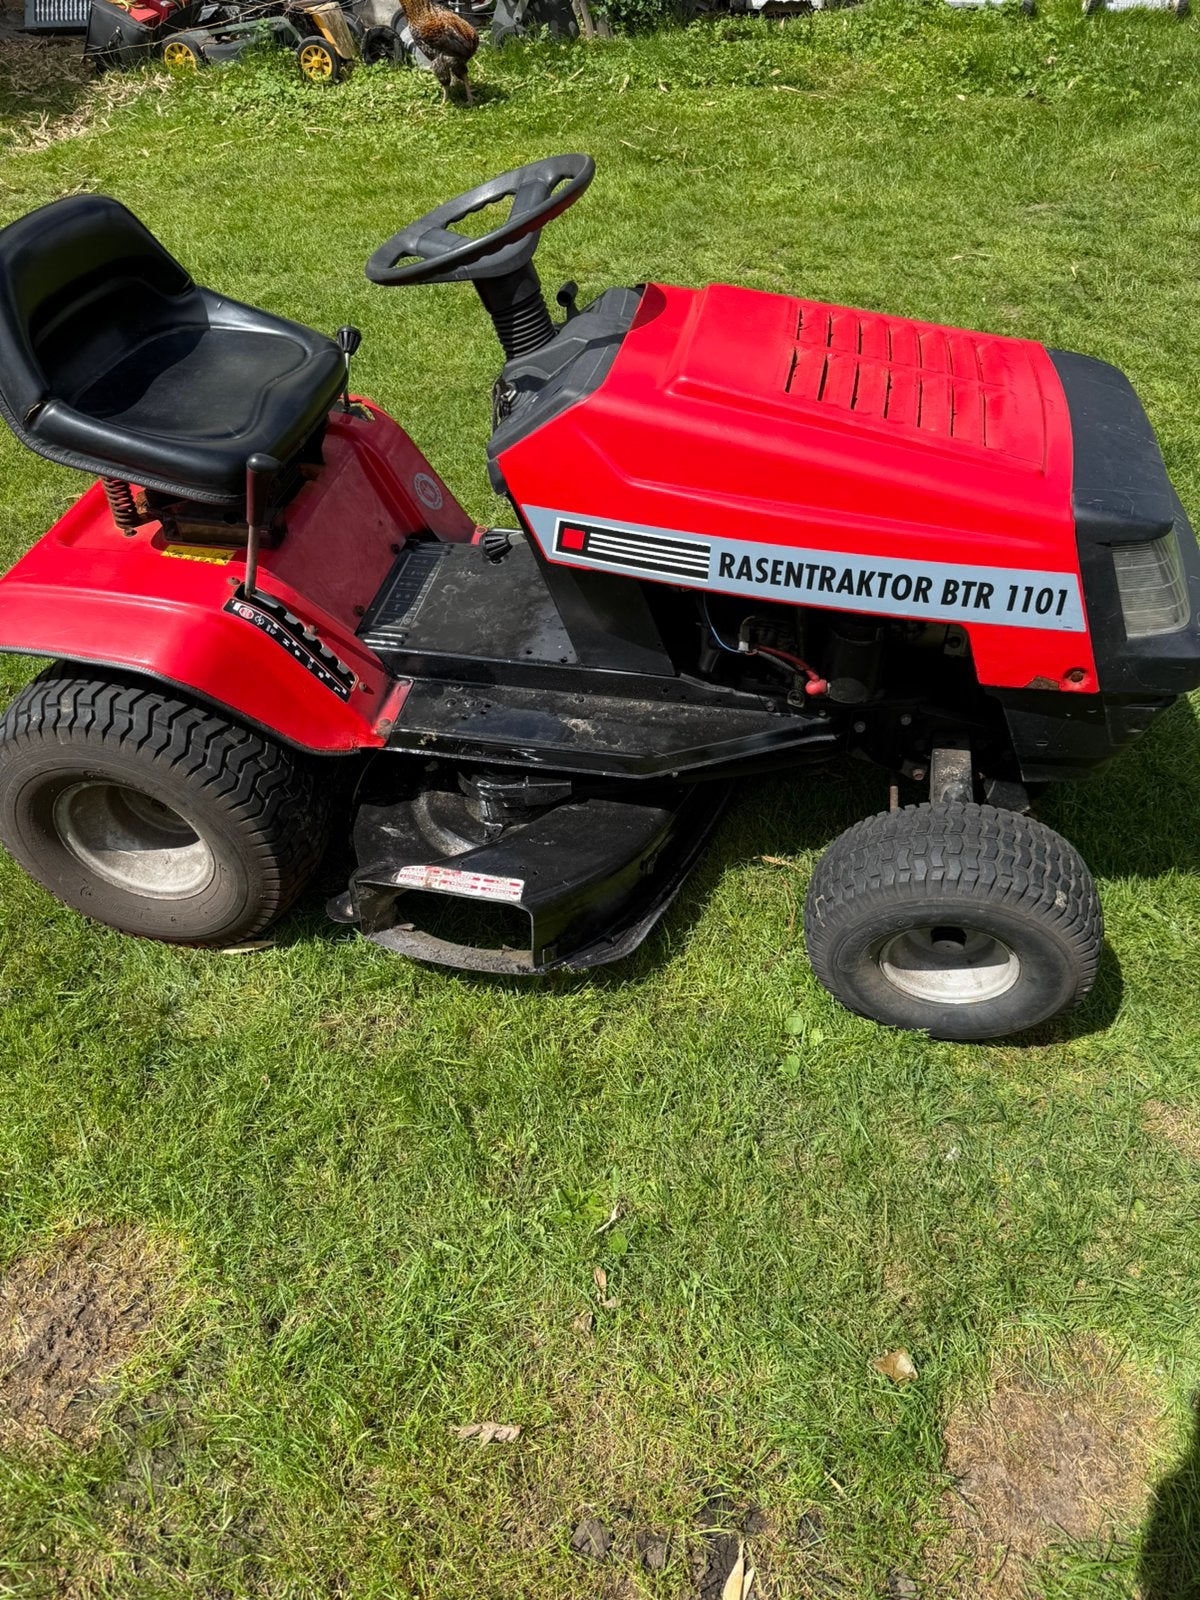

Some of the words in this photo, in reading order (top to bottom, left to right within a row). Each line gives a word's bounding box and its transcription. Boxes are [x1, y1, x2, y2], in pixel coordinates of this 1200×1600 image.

[719, 552, 933, 604] RASENTRAKTOR
[940, 579, 995, 610] BTR
[1006, 585, 1068, 616] 1101
